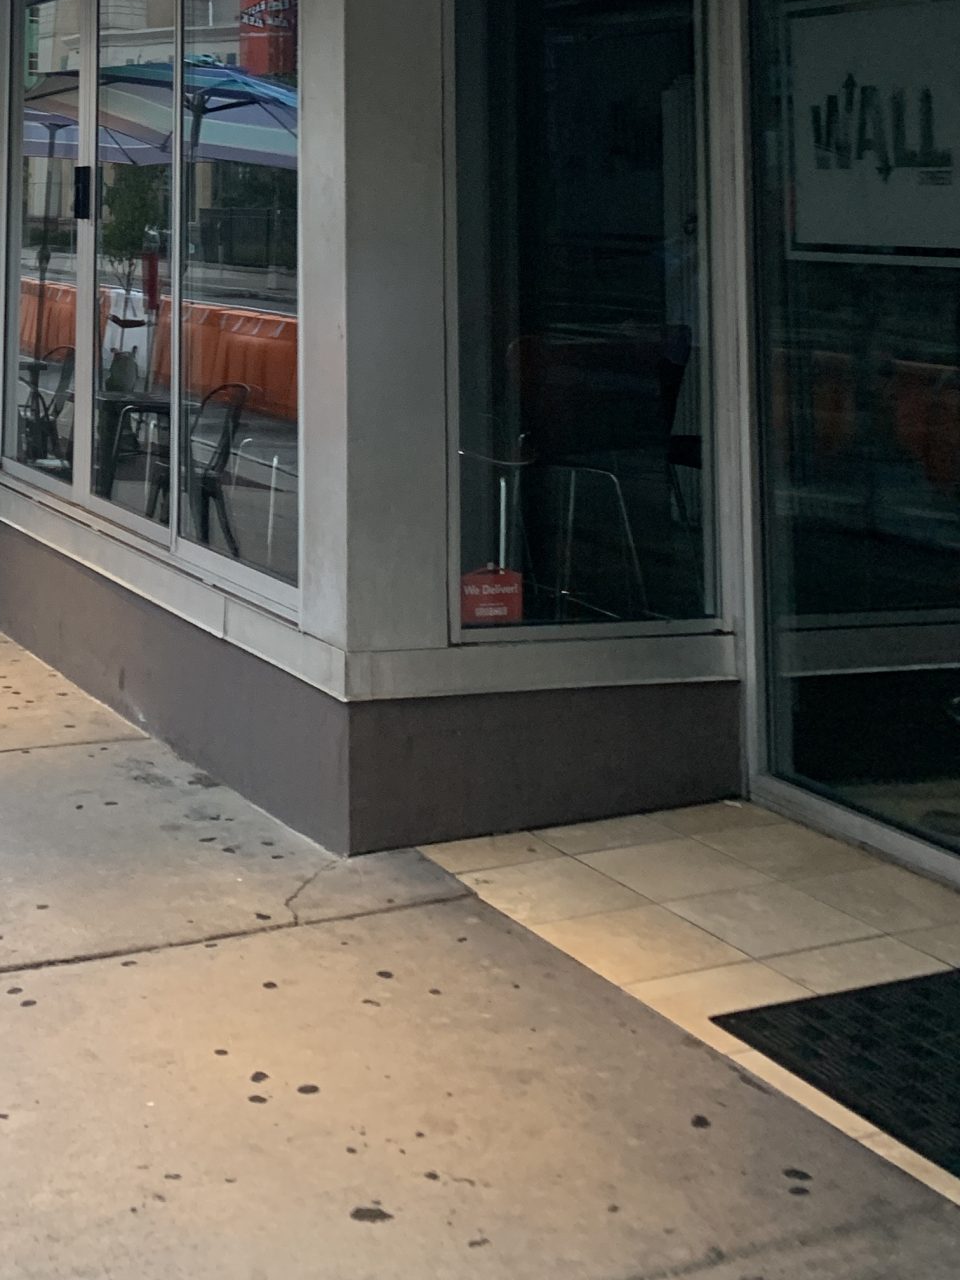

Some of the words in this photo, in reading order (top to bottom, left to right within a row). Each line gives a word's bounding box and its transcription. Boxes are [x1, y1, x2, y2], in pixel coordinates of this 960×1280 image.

[810, 73, 952, 184] WALL
[463, 584, 480, 596] We
[481, 583, 519, 595] Deliver!
